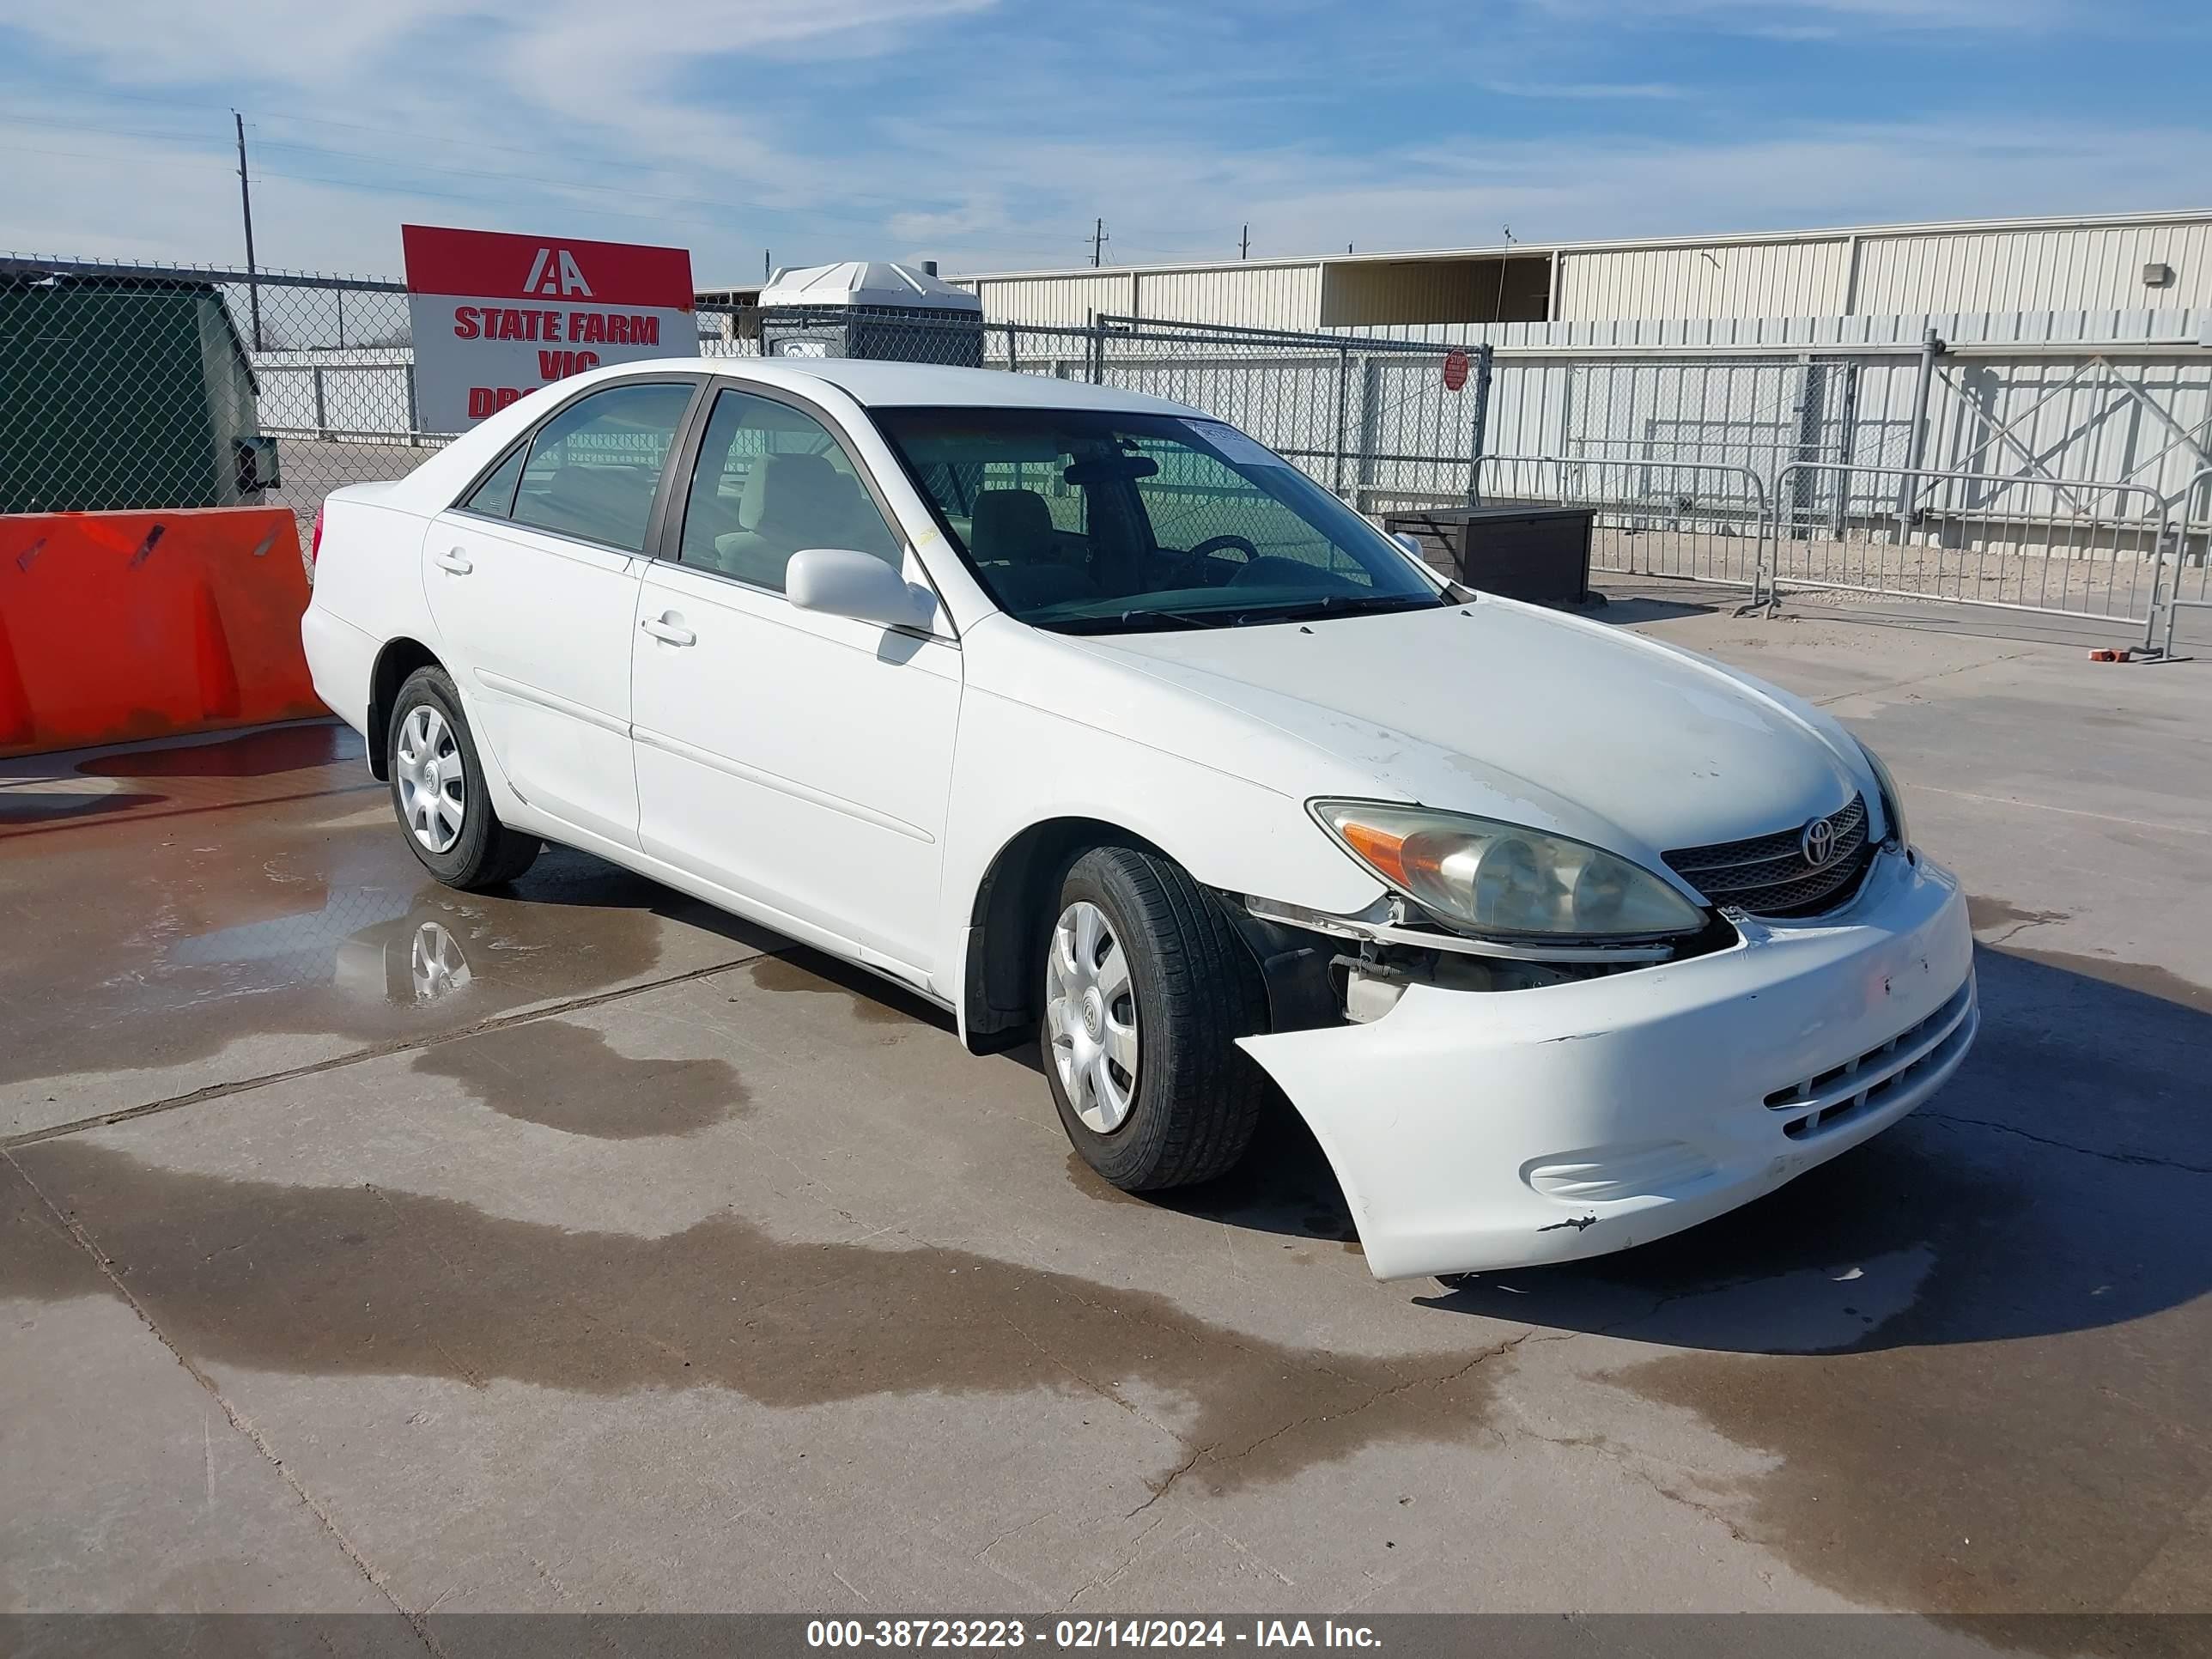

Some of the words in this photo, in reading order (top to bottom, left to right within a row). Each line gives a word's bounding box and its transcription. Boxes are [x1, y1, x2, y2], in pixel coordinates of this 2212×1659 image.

[453, 307, 562, 343] STATE
[568, 312, 659, 346] FARM
[1450, 356, 1466, 364] STOP
